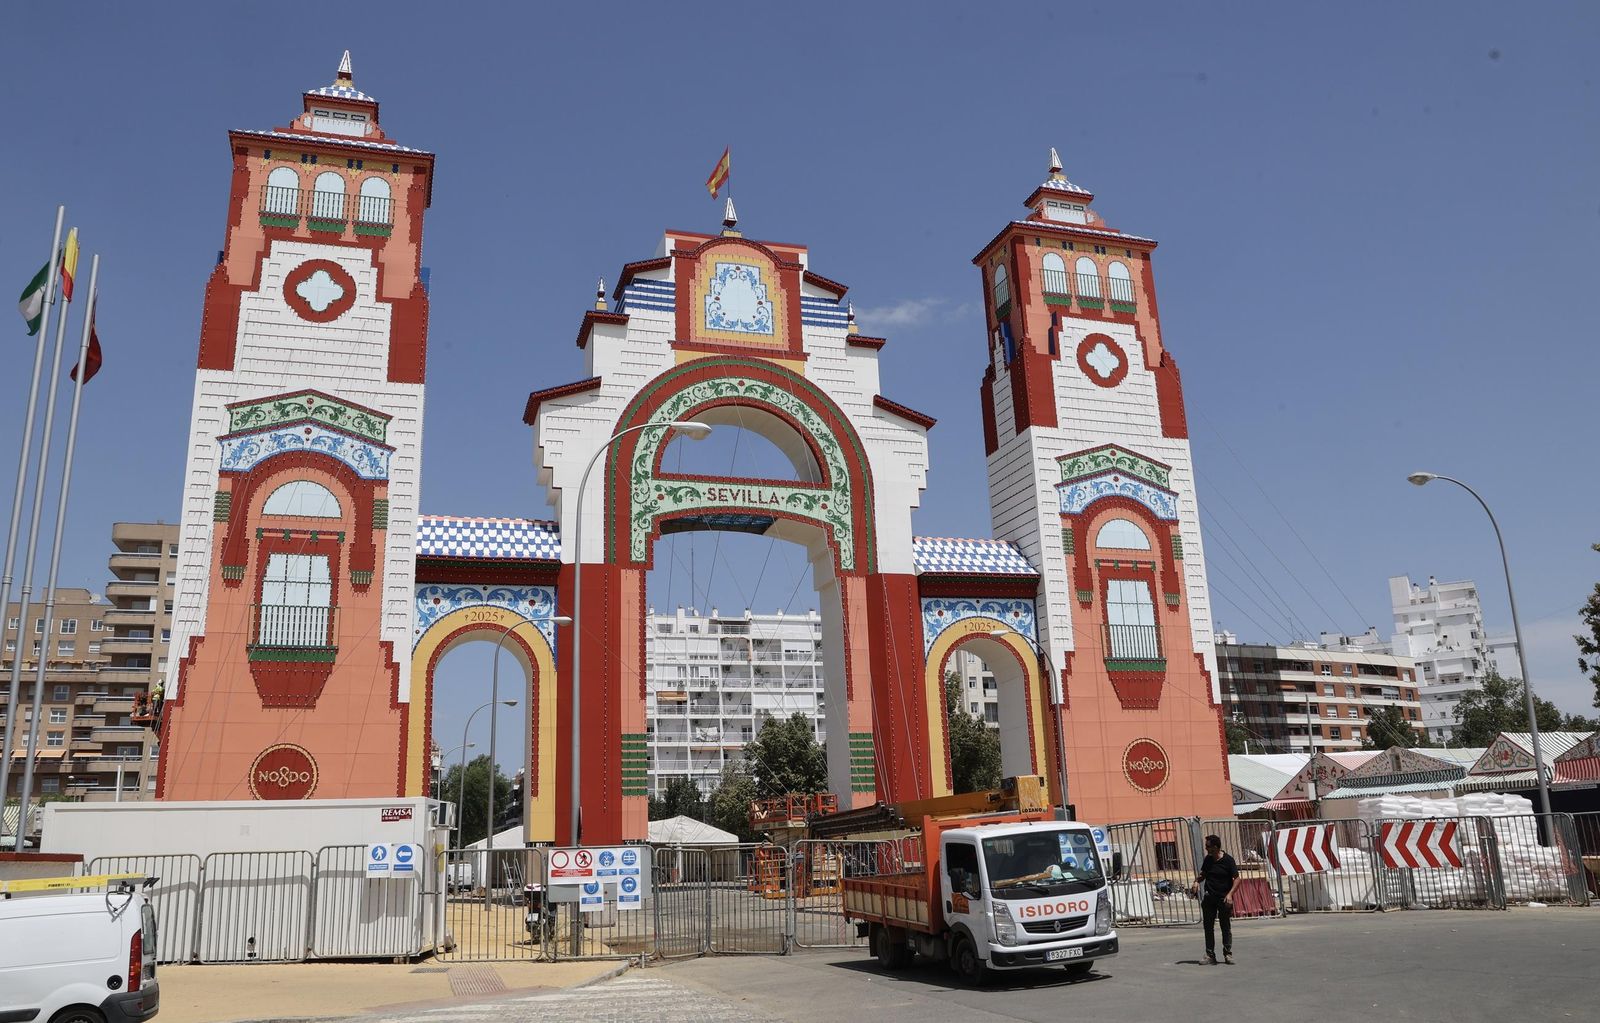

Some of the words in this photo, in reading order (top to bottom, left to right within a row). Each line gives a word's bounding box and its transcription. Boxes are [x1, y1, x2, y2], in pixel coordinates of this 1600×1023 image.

[706, 487, 780, 506] SEVILLA
[470, 611, 499, 622] 2025
[969, 621, 992, 632] 2025
[382, 808, 412, 817] REMSA
[1019, 900, 1089, 918] ISIDORO
